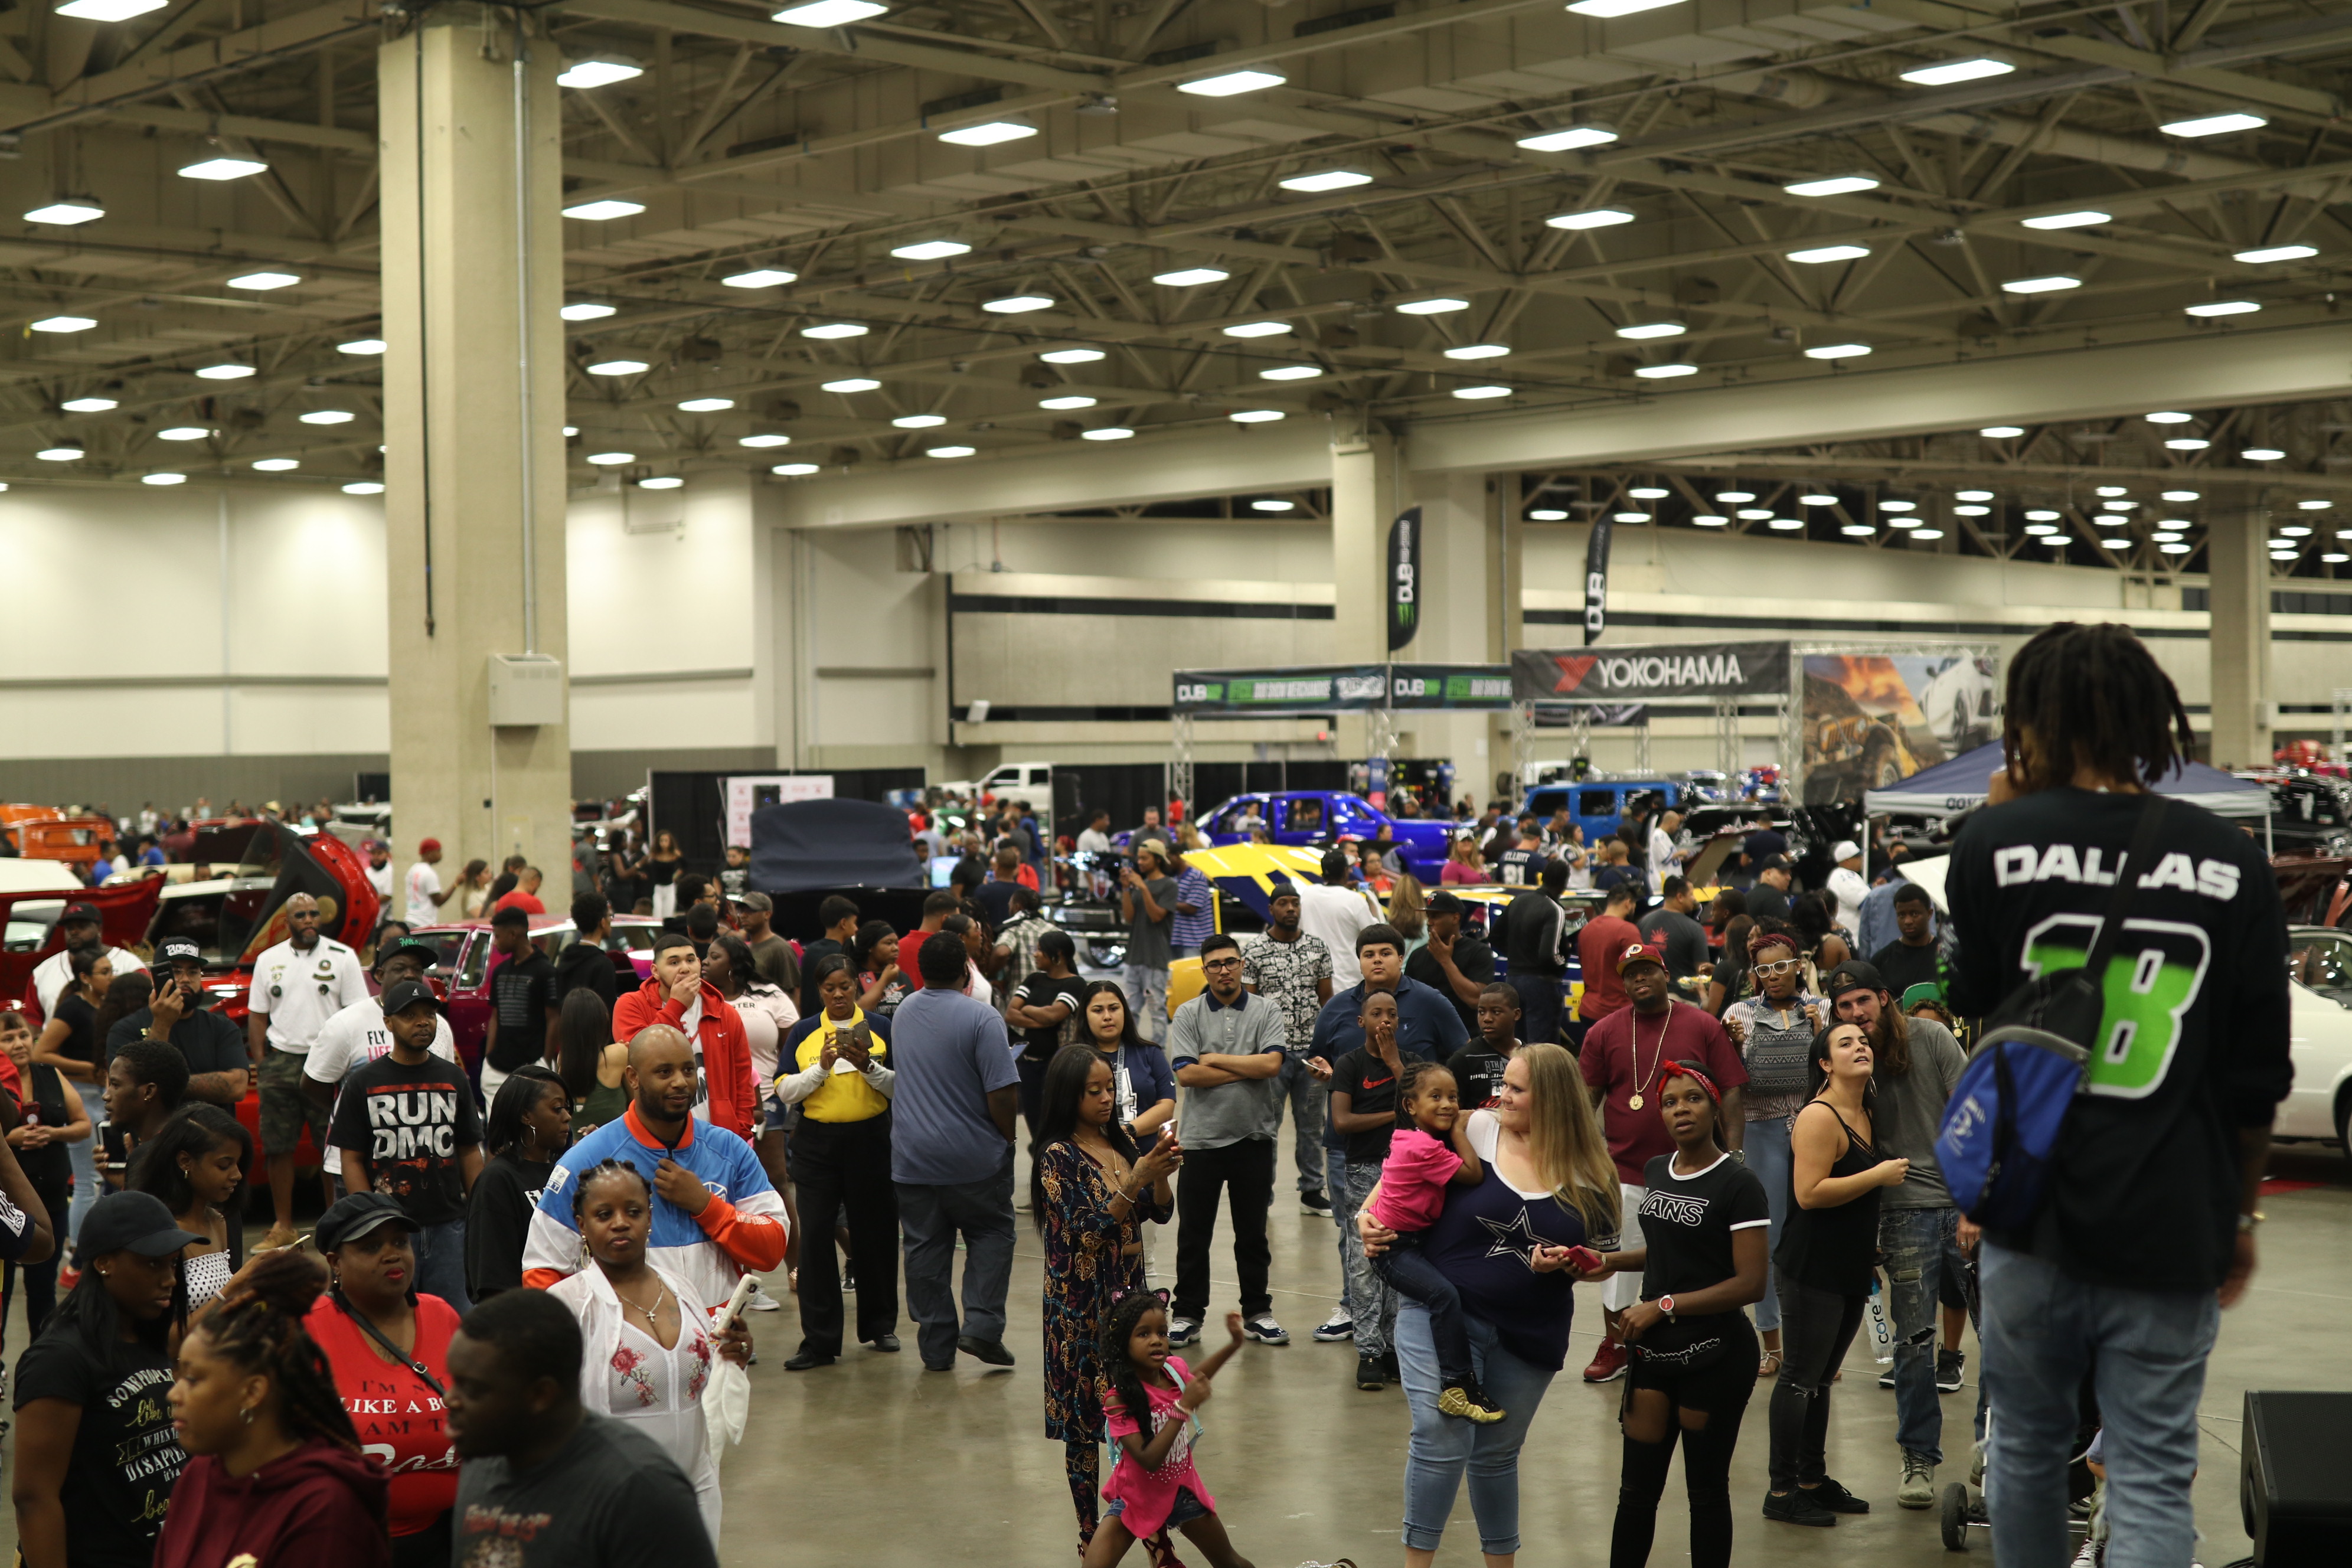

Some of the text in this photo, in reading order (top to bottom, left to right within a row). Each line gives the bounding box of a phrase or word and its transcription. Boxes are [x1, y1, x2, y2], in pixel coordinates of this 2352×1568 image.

[1397, 563, 1413, 603] DUB
[1586, 571, 1605, 631] DUB
[1598, 654, 1743, 688] YOKOHAMA
[1177, 684, 1207, 701] DUB
[1395, 679, 1425, 697] DUB
[1504, 851, 1531, 863] ELLIOTT
[367, 1030, 386, 1045] FLY
[367, 1092, 457, 1128] RUN
[373, 1125, 454, 1159] DMC
[1638, 1187, 1710, 1226] VANS
[14, 1214, 23, 1231] USA
[1872, 1305, 1889, 1344] core
[362, 1377, 445, 1394] I'M NT
[340, 1397, 397, 1413] LIKE
[406, 1400, 422, 1413] A
[365, 1421, 410, 1435] AM
[143, 1429, 170, 1448] WHEN
